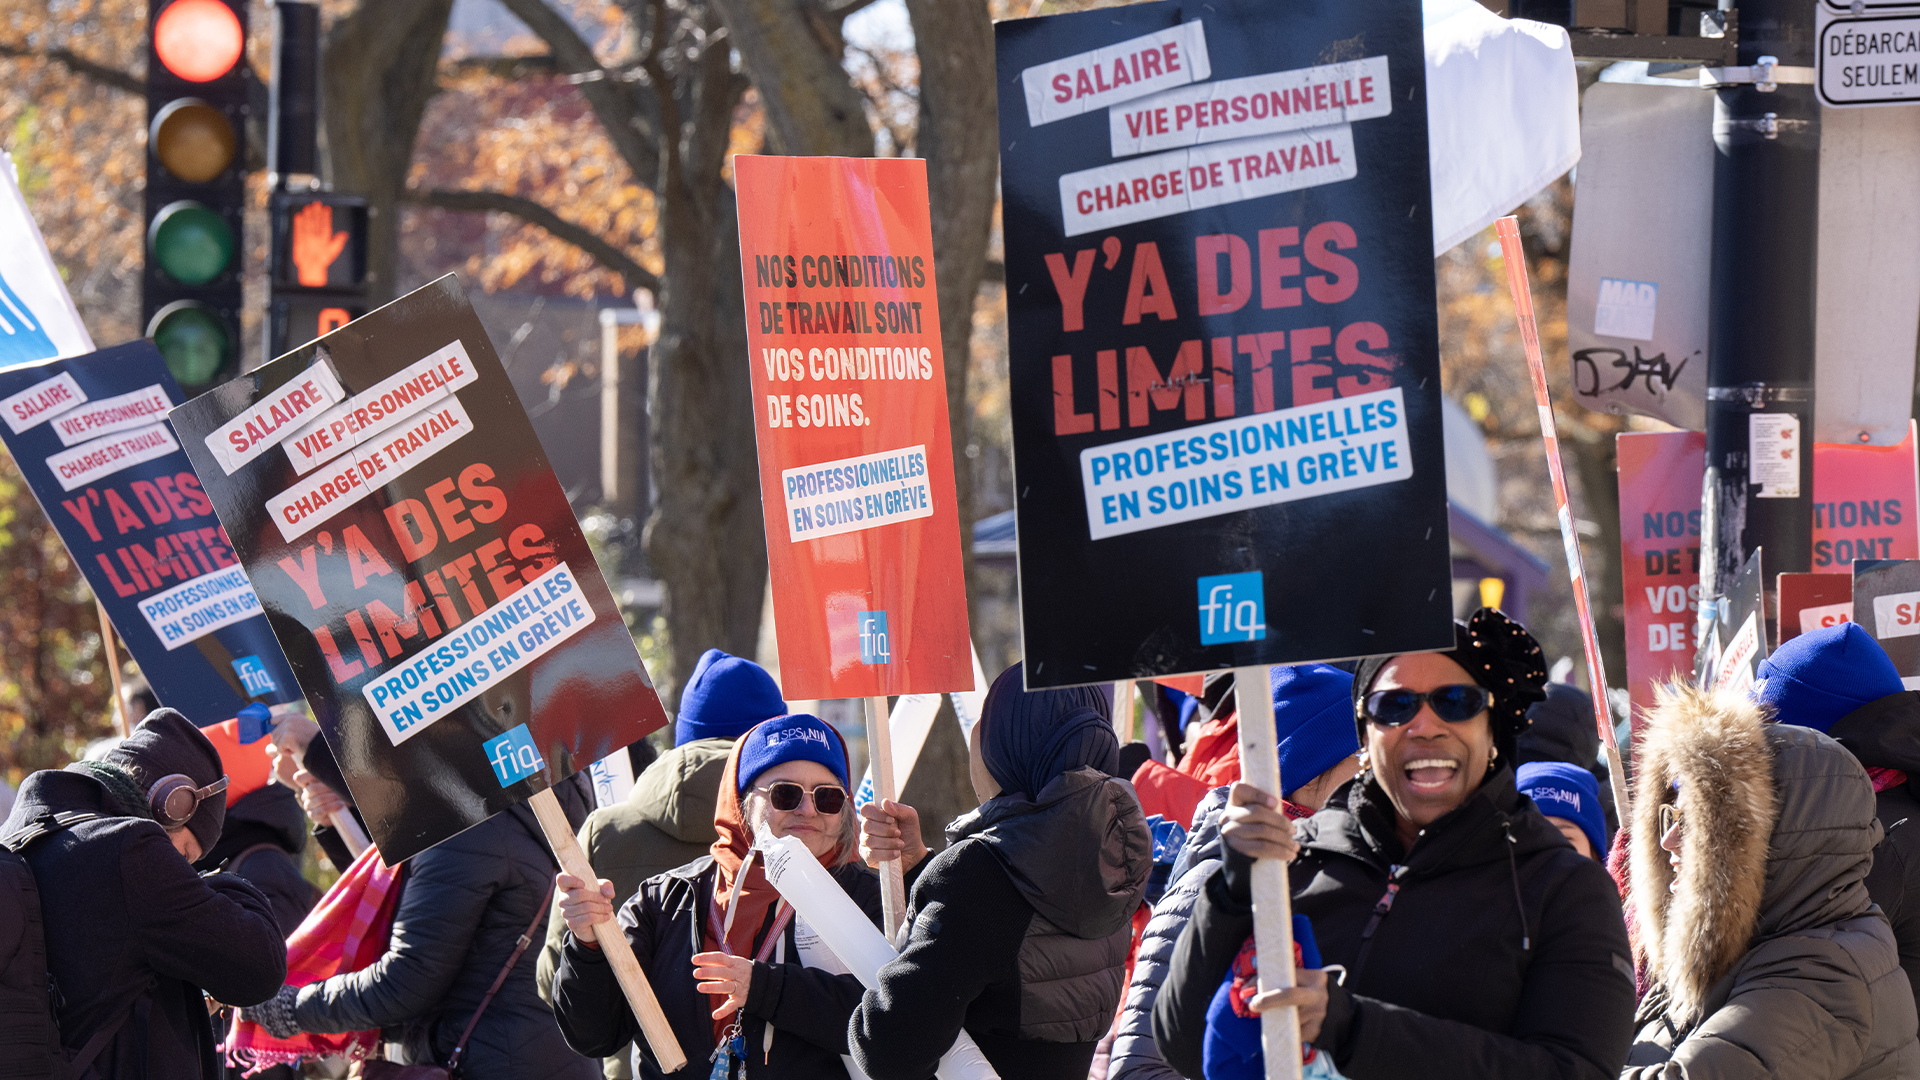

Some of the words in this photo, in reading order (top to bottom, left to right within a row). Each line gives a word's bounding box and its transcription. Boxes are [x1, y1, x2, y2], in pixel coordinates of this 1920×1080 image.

[1830, 28, 1920, 56] DÉBARCA
[1052, 42, 1181, 104] SALAIRE
[1842, 63, 1918, 87] SEULEM
[1125, 107, 1170, 139] VIE
[1176, 76, 1375, 132] PERSONNELLE
[1076, 170, 1184, 216] CHARGE
[1189, 161, 1224, 192] DE
[1228, 139, 1341, 183] TRAVAIL
[755, 254, 797, 289] NOS
[801, 254, 926, 289] CONDITIONS
[1044, 236, 1178, 332] Y'A
[1195, 221, 1360, 317] DES
[759, 301, 785, 336] DE
[786, 301, 872, 335] TRAVAIL
[874, 301, 923, 335] SONT
[762, 346, 804, 382] VOS
[809, 346, 933, 381] CONDITIONS
[1051, 321, 1396, 436] LIMITES
[12, 383, 72, 421] SALAIRE
[60, 415, 86, 435] VIE
[82, 396, 166, 430] PERSONNELLE
[228, 380, 324, 454] SALAIRE
[294, 430, 333, 460] VIE
[329, 356, 465, 446] PERSONNELLE
[768, 394, 793, 429] DE
[796, 393, 870, 428] SOINS.
[59, 450, 109, 479] CHARGE
[106, 443, 126, 460] DE
[123, 430, 167, 454] TRAVAIL
[282, 467, 362, 526] CHARGE
[358, 456, 387, 481] DE
[382, 409, 460, 466] TRAVAIL
[1091, 399, 1398, 486] PROFESSIONNELLES
[786, 454, 925, 501] PROFESSIONNELLES
[1102, 490, 1141, 525] EN
[1148, 470, 1244, 515] SOINS
[1251, 461, 1290, 494] EN
[1299, 440, 1399, 485] GRÈVE
[61, 487, 146, 542] Y'A
[130, 472, 214, 526] DES
[793, 506, 813, 533] EN
[816, 496, 864, 528] SOINS
[865, 494, 885, 519] EN
[884, 481, 927, 515] GRÈVE
[277, 530, 394, 611] Y'A
[382, 462, 508, 563] DES
[1815, 537, 1893, 567] SONT
[1645, 548, 1681, 576] DE
[162, 621, 185, 641] EN
[181, 603, 227, 632] SOINS
[223, 596, 243, 616] EN
[313, 523, 560, 684] LIMITES
[1198, 584, 1267, 641] fiq
[370, 570, 575, 709] PROFESSIONNELLES
[859, 619, 890, 664] fiq
[1648, 622, 1686, 651] DE
[239, 662, 277, 692] fiq
[389, 703, 419, 734] EN
[421, 660, 491, 715] SOINS
[485, 646, 520, 673] EN
[520, 598, 586, 653] GRÈVE
[490, 739, 545, 781] fiq
